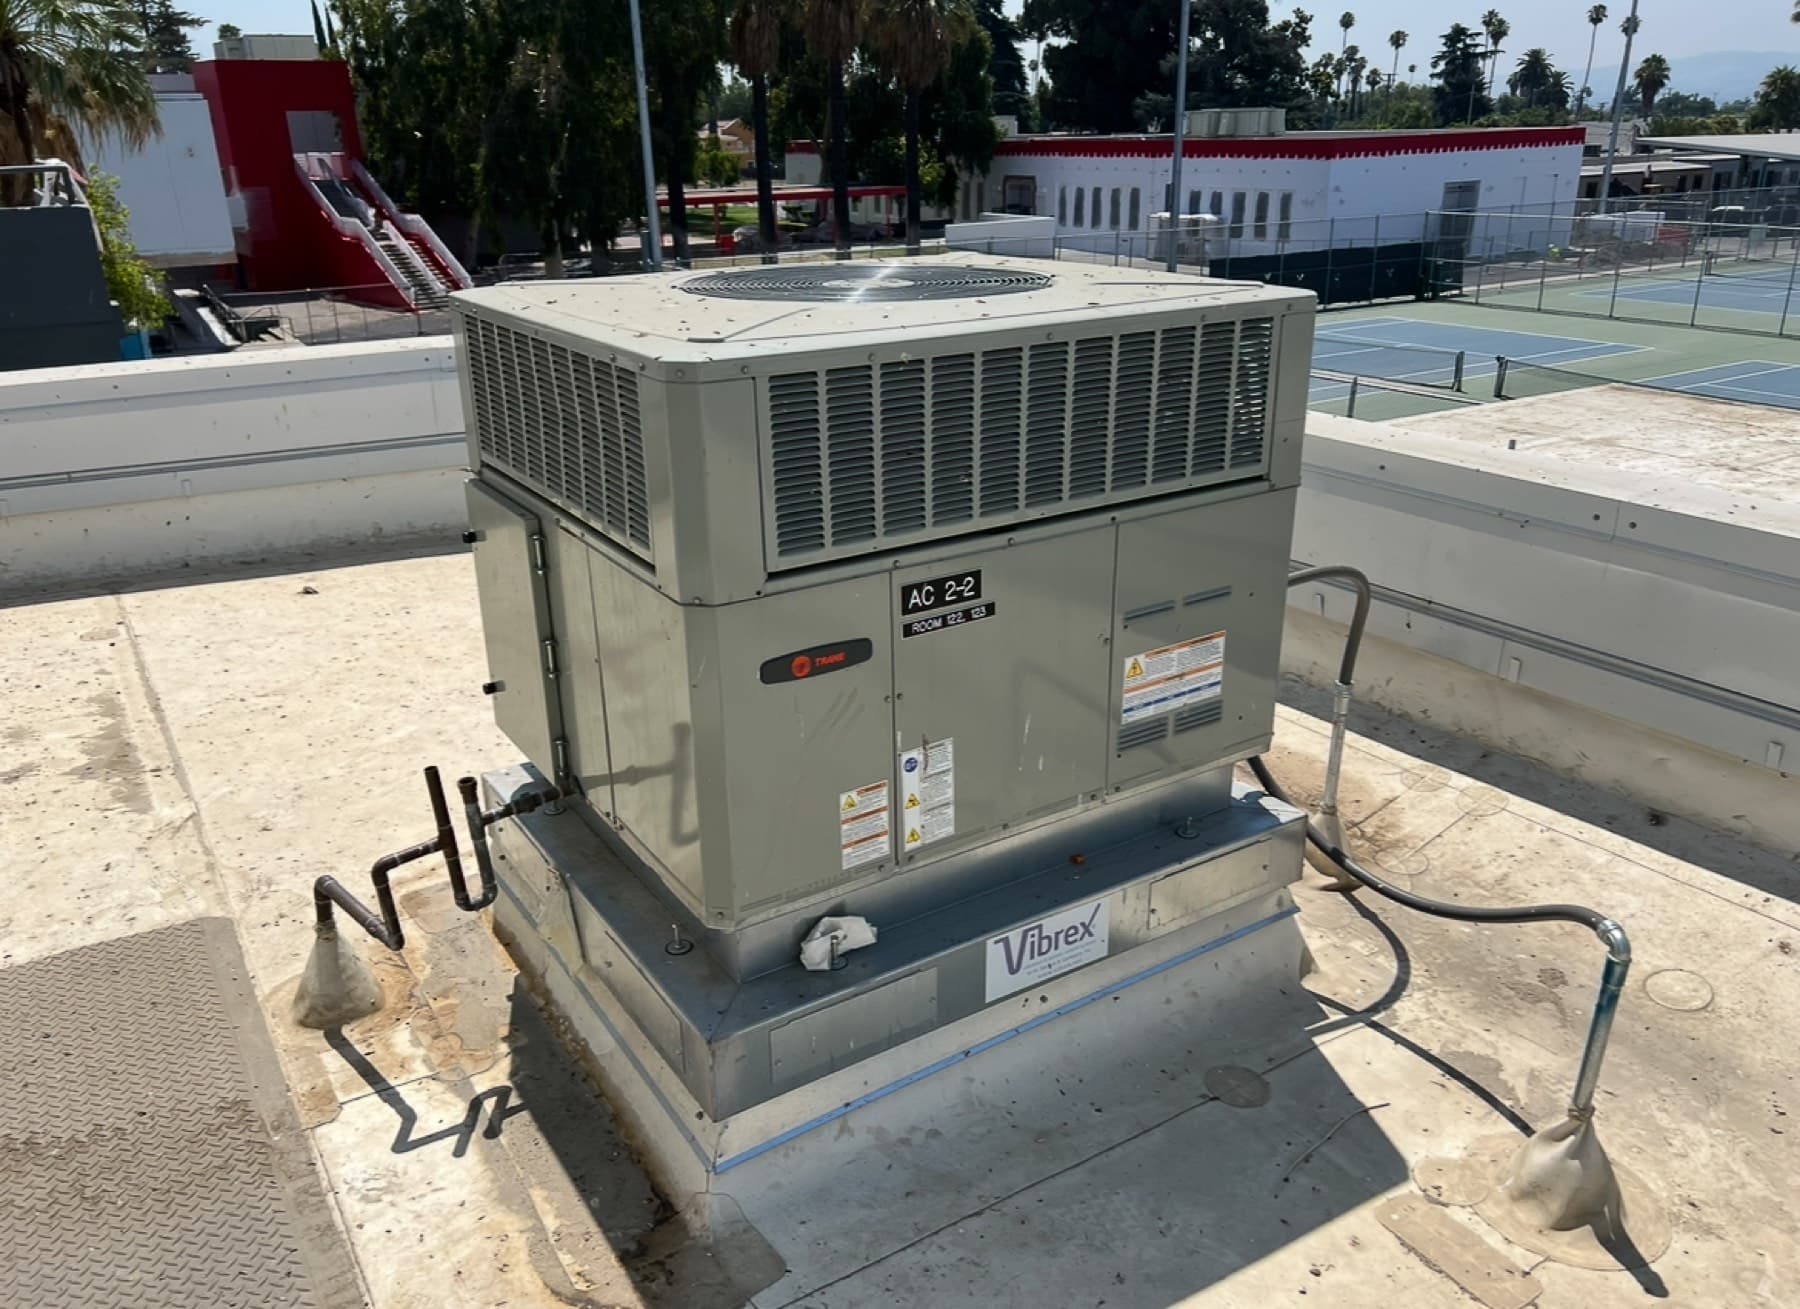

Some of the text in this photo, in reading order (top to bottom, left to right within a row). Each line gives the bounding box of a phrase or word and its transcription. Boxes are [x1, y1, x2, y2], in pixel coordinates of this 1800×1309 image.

[908, 576, 976, 609] AC 2-2
[911, 616, 943, 634] ROOM
[993, 902, 1101, 976] Vibrex
